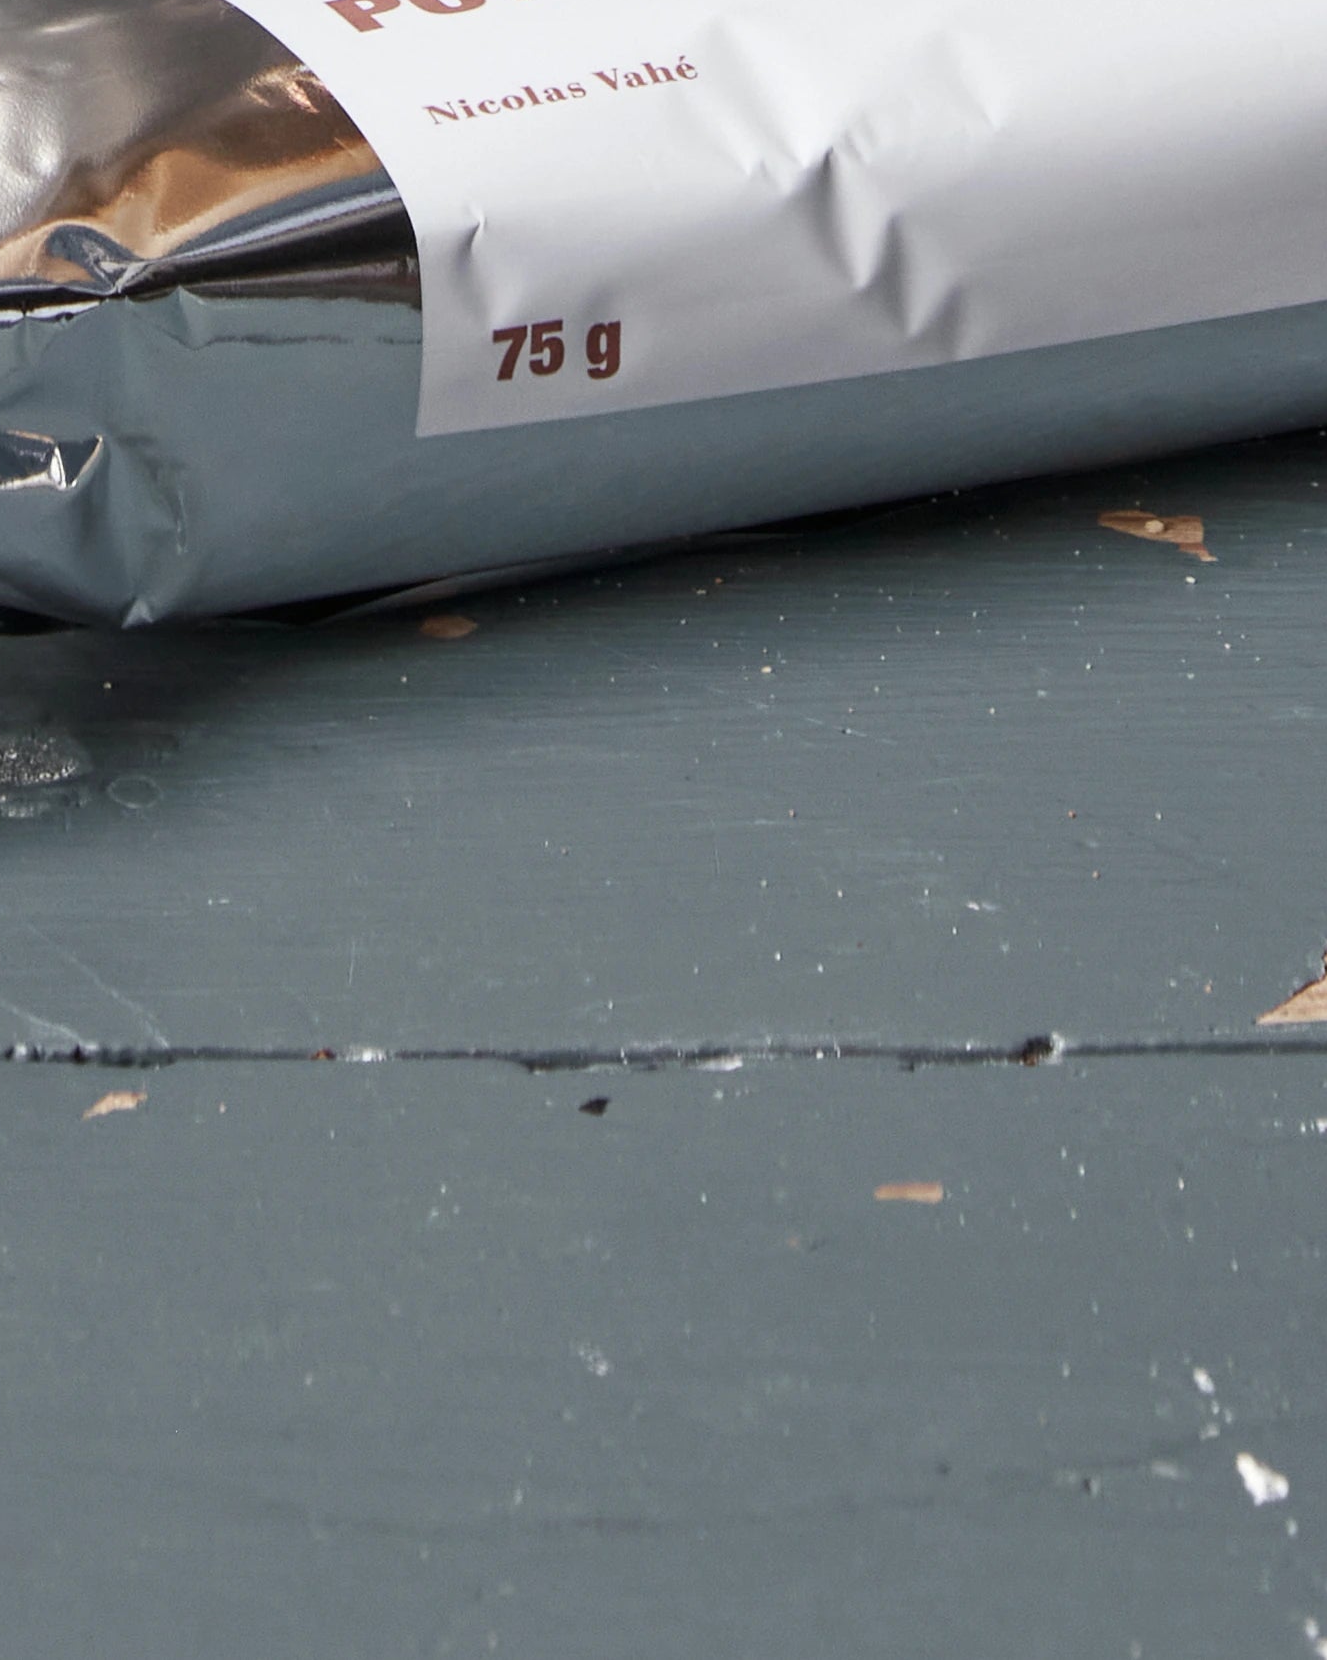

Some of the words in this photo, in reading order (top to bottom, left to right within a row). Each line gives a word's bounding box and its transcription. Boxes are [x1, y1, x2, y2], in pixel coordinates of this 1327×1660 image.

[421, 78, 587, 126] Nicolas
[592, 55, 700, 92] Vahé
[492, 319, 566, 381] 75
[585, 320, 621, 380] g
